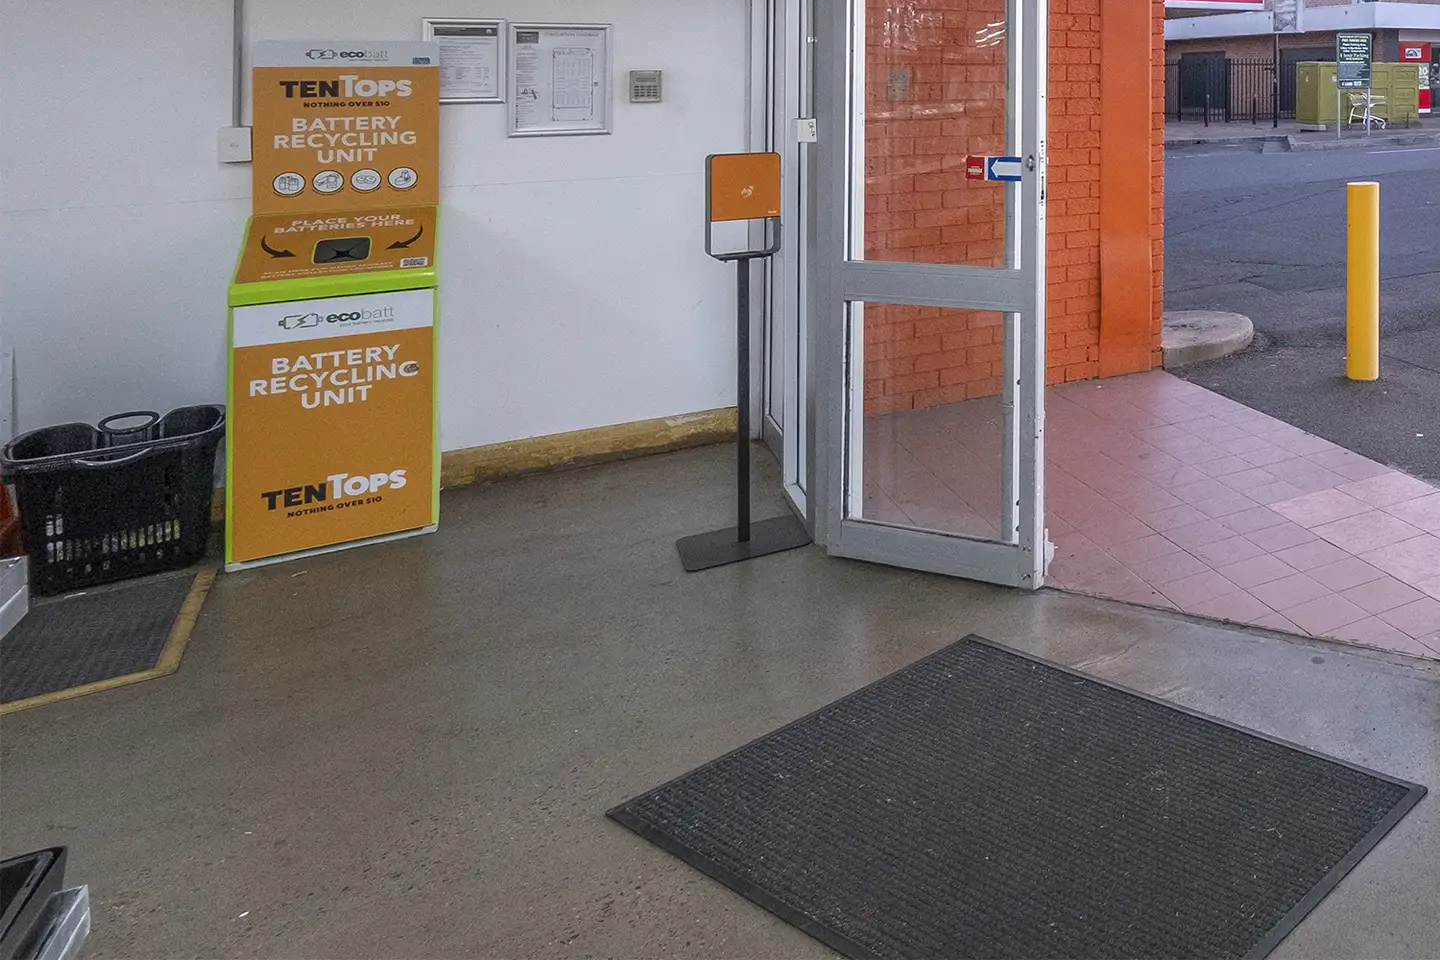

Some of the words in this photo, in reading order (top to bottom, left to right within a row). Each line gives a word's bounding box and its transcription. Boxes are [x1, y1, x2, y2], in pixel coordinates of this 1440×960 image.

[339, 49, 389, 59] ecobatt
[292, 116, 401, 132] BATTERY
[274, 131, 417, 149] RECYCLING
[317, 148, 378, 164] UNIT
[273, 222, 368, 234] BATTERIES
[371, 219, 415, 228] HERE
[292, 217, 347, 227] PLACE
[353, 214, 401, 223] YOUR
[326, 306, 394, 323] ecobatt
[272, 344, 400, 375] BATTERY
[249, 360, 419, 397] RECYCLING
[301, 385, 373, 410] UNIT
[287, 505, 334, 518] NOTHING
[336, 499, 364, 510] OVER
[366, 496, 382, 505] $10
